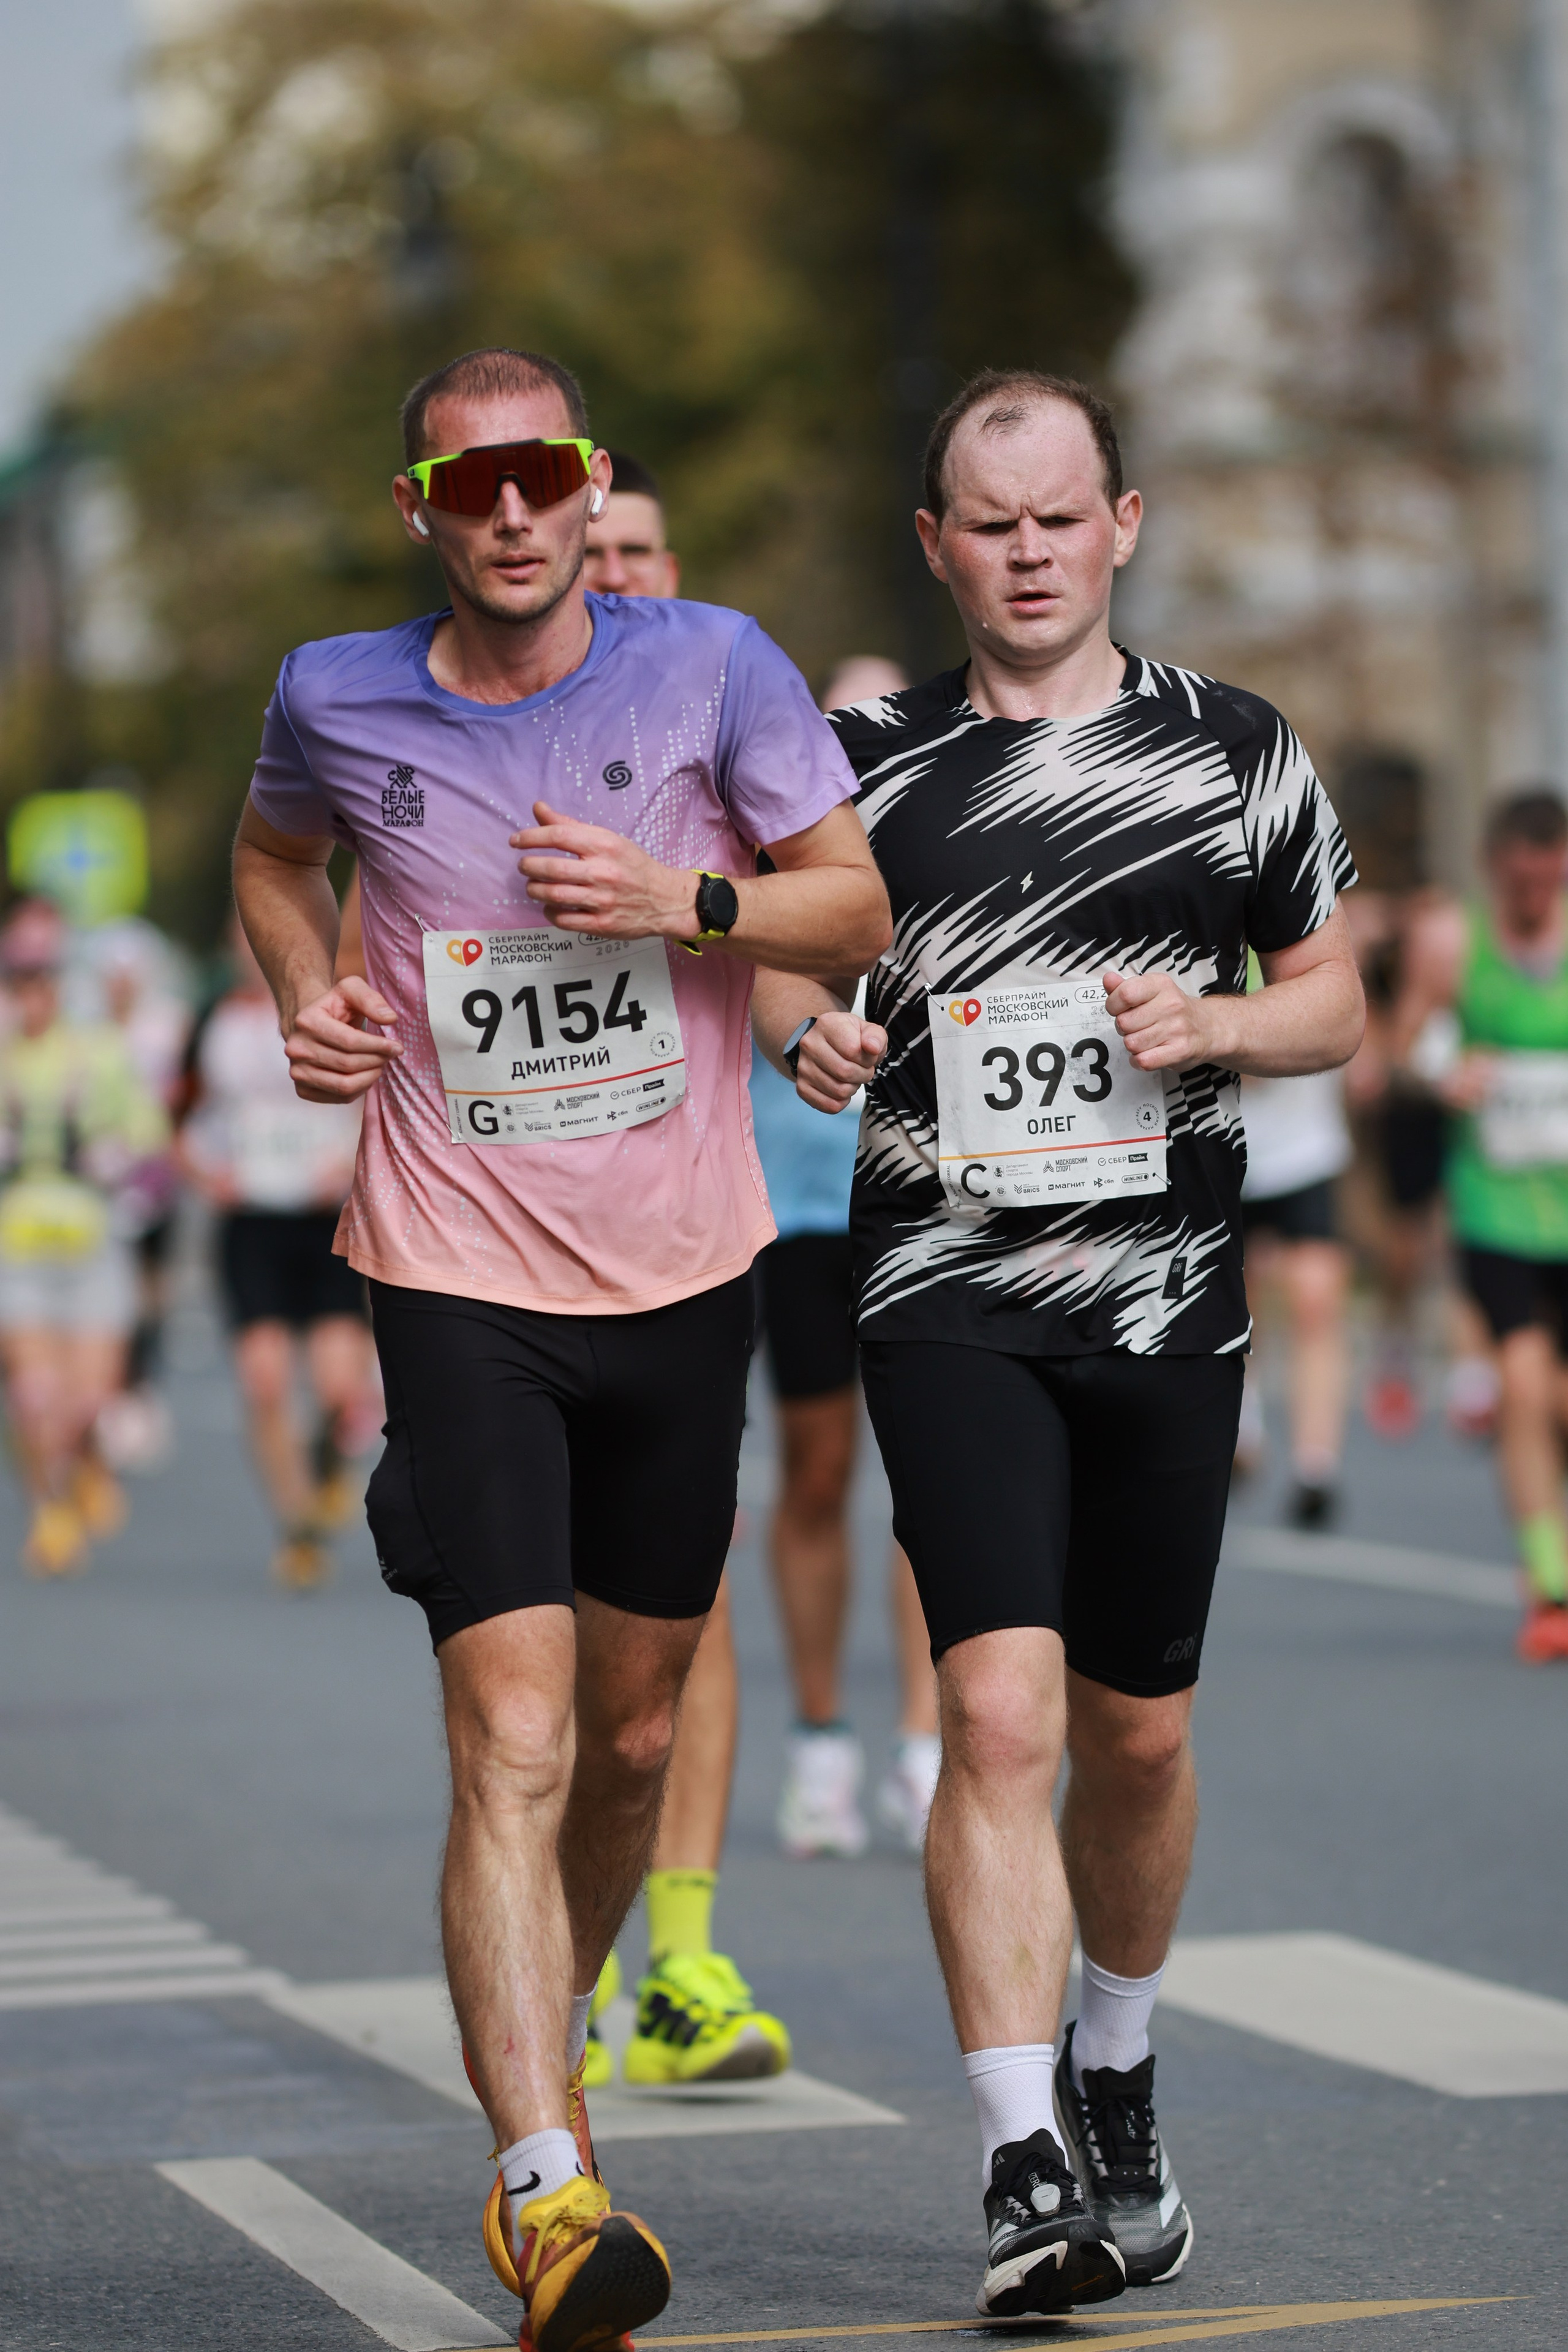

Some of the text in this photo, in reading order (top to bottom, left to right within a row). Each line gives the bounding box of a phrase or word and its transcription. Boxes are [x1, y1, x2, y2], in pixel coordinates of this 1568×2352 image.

[382, 790, 424, 804] БЕЛЫЕ
[381, 805, 424, 819] НОЧИ
[489, 933, 549, 943] СБЕРПРАЙМ
[490, 940, 573, 955] МОСКОВСКИЙ
[491, 953, 552, 965] МАРАФОН
[987, 991, 1046, 1003] СБЕРПРАЙМ
[461, 970, 647, 1053] 9154
[987, 997, 1069, 1014] МОСКОВСКИЙ
[989, 1011, 1048, 1025] МАРАФОН
[658, 1039, 665, 1049] 1
[511, 1046, 611, 1080] ДМИТРИЙ
[981, 1038, 1112, 1111] 393
[566, 1091, 600, 1102] МОСКОВСКИЙ
[621, 1087, 641, 1096] СБЕР
[638, 1100, 660, 1110] WINLINE
[468, 1100, 499, 1136] G
[1143, 1111, 1152, 1121] 4
[1027, 1115, 1076, 1135] ОЛЕГ
[1055, 1156, 1088, 1166] МОСКОВСКИЙ
[961, 1163, 990, 1199] C
